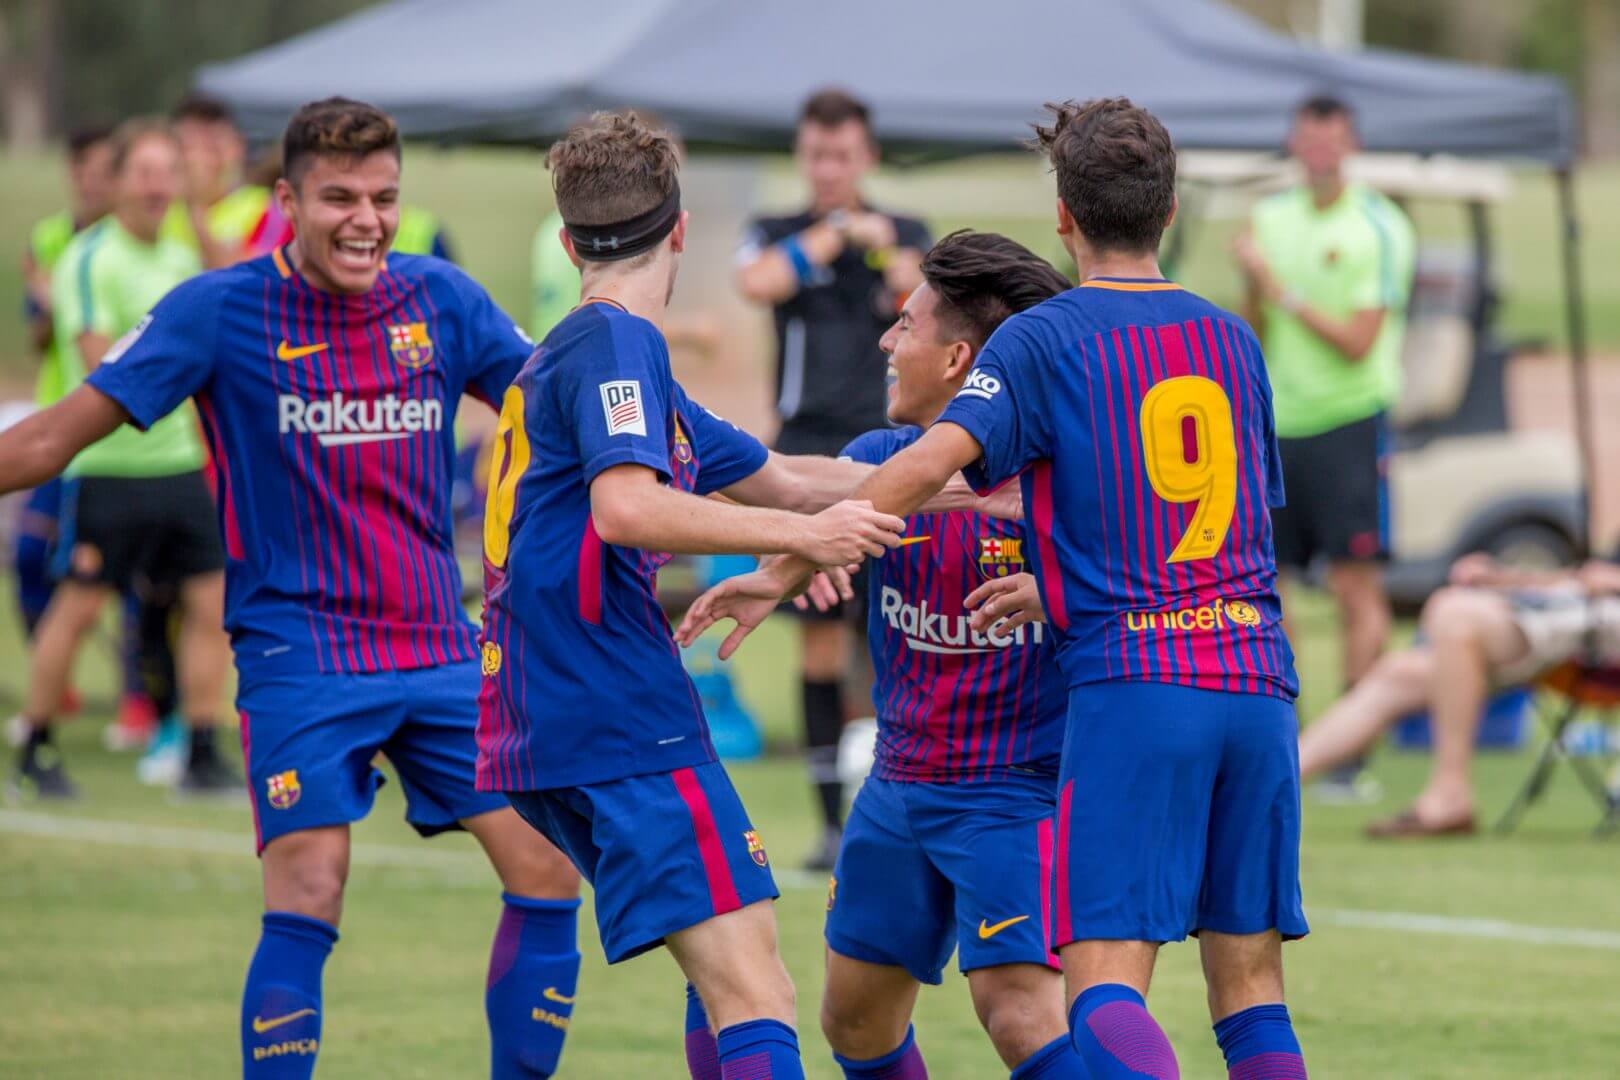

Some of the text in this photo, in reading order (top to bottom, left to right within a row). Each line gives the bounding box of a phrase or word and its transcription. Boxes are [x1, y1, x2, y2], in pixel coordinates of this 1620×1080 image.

[606, 386, 635, 409] DA
[964, 368, 1000, 394] ko
[278, 392, 442, 433] Rakuten
[1140, 375, 1237, 563] 9
[1127, 598, 1224, 631] unicef
